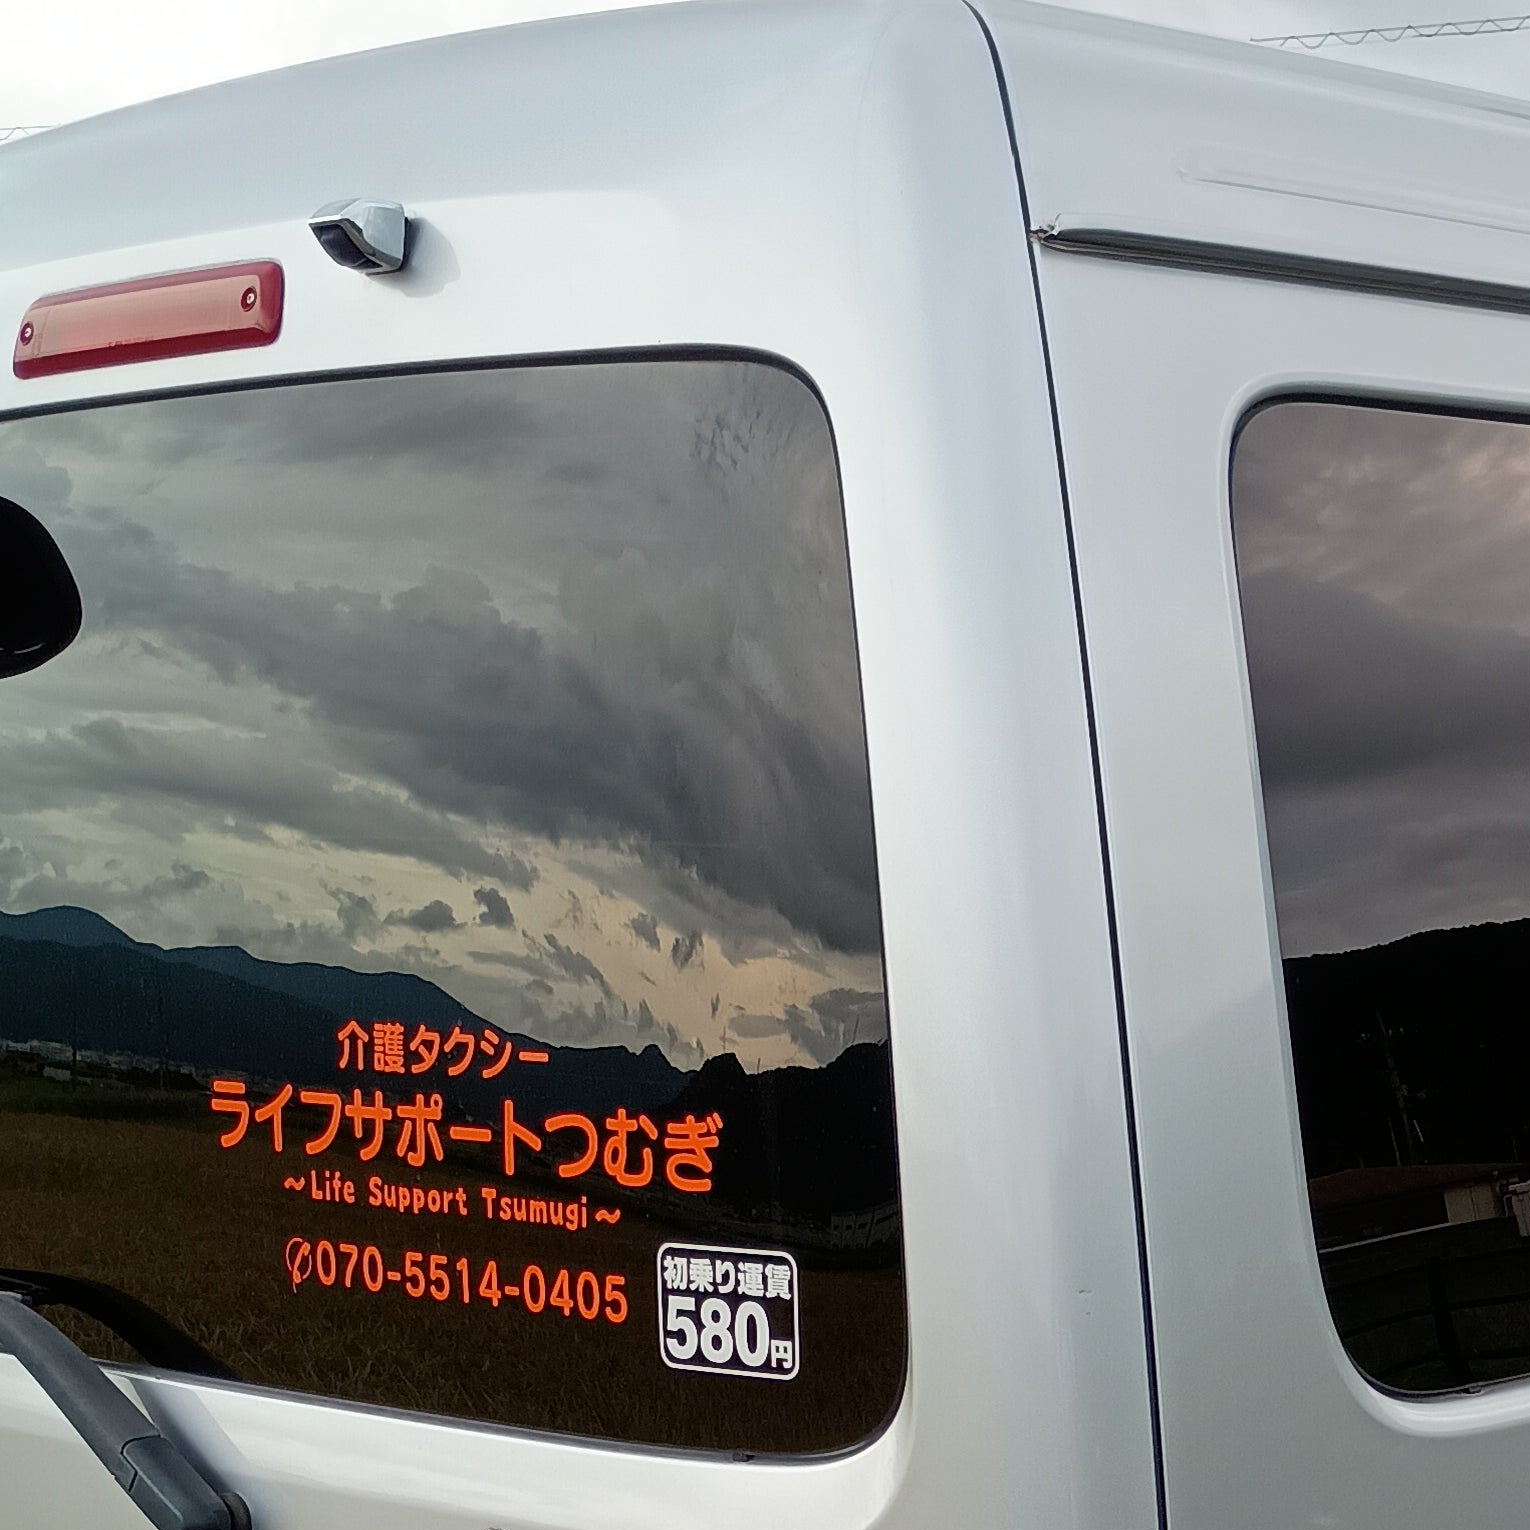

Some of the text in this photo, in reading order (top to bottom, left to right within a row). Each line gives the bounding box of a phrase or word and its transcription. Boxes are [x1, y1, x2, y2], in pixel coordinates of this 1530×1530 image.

[337, 1020, 549, 1079] 介護タクシー
[210, 1079, 725, 1192] ライフサポートつむぎ
[368, 1176, 468, 1216] Support
[315, 1240, 628, 1324] 070-5514-0405
[663, 1255, 792, 1300] 初乗り運賃
[666, 1295, 793, 1369] 580円
